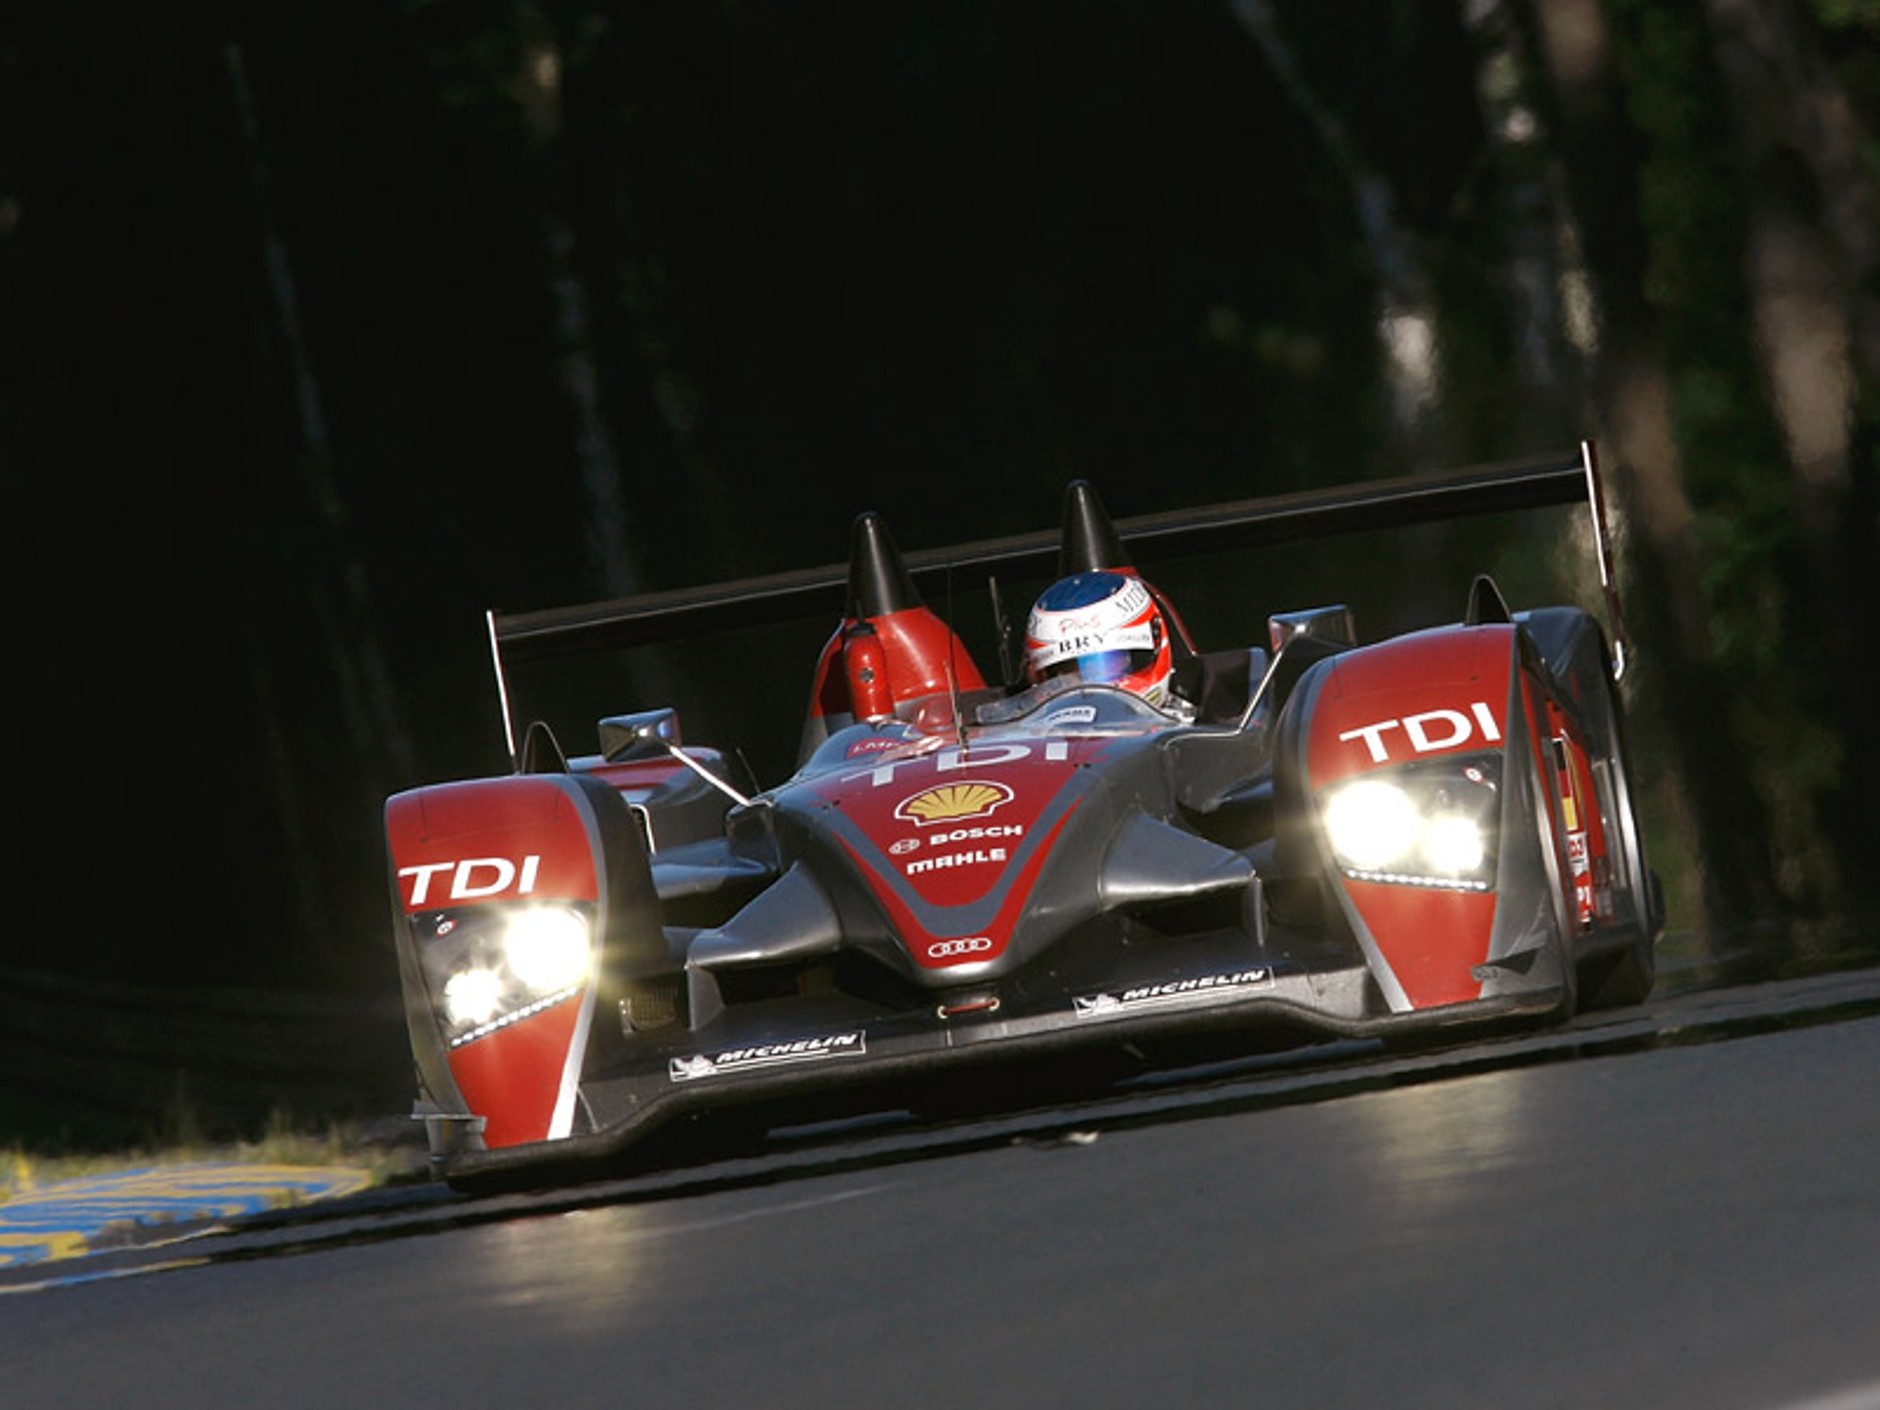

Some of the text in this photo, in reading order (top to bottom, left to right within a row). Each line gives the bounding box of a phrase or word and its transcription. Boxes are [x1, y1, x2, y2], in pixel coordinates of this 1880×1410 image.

[1339, 702, 1501, 763] TDI
[841, 741, 1068, 787] TDI
[929, 825, 1023, 846] BOSCH
[906, 848, 1006, 875] MAHLE
[398, 855, 541, 906] TDI
[1122, 970, 1266, 1001] MICHELIN
[715, 1033, 857, 1064] MICHELIN
